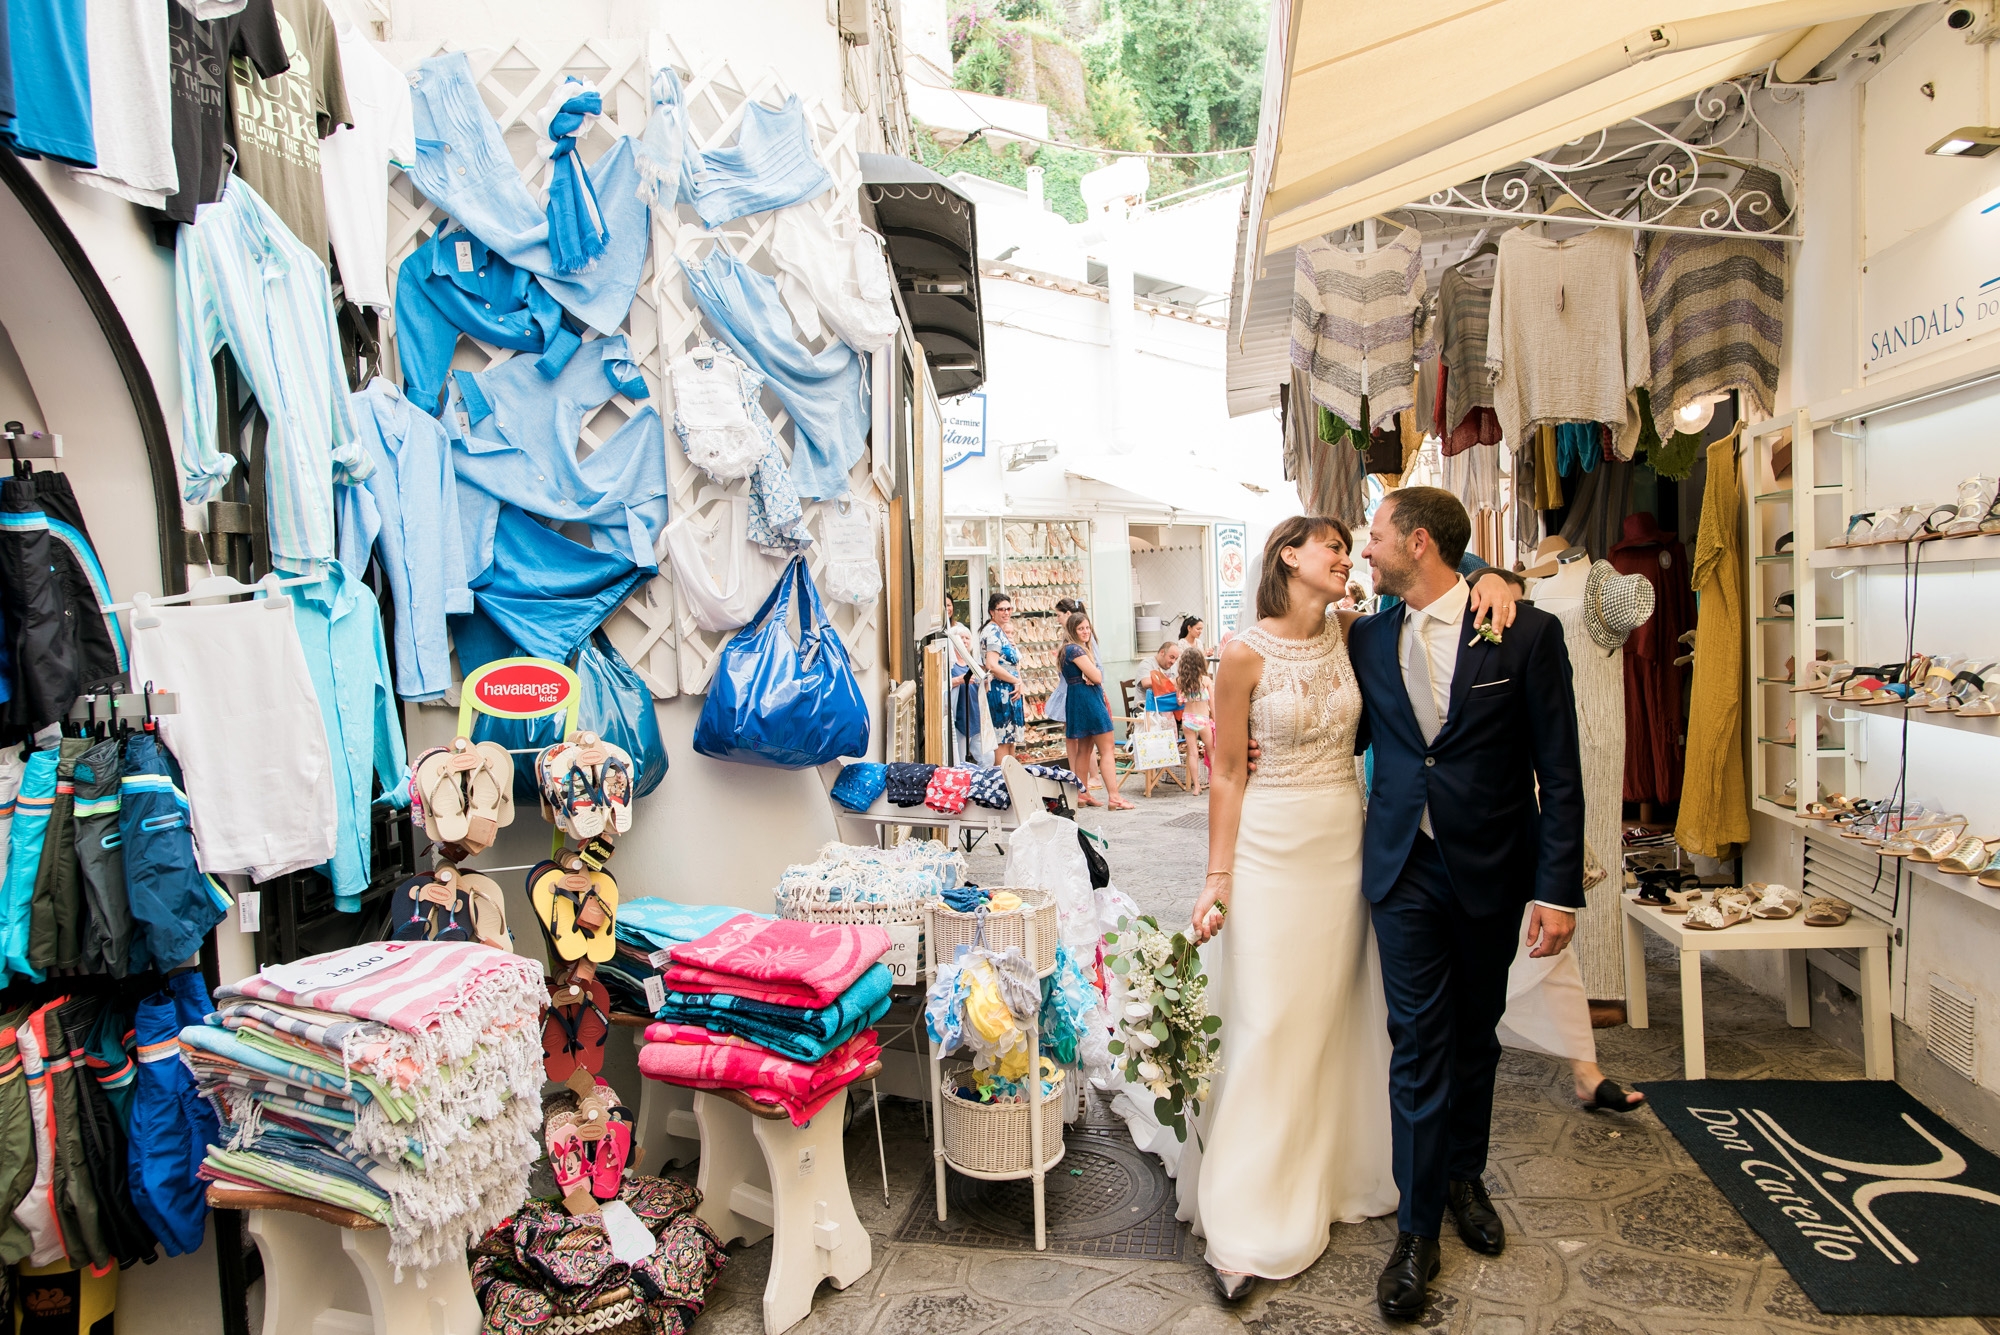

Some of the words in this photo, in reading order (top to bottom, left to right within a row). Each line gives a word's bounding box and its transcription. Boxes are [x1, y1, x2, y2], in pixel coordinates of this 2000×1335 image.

[282, 133, 301, 156] THE
[1871, 296, 1965, 361] SANDALS
[1977, 300, 2000, 321] DO
[949, 417, 981, 427] Carmine
[483, 682, 559, 696] havaianas
[539, 694, 558, 702] kids
[1687, 1107, 1754, 1151] Don
[1741, 1160, 1863, 1261] Catello
